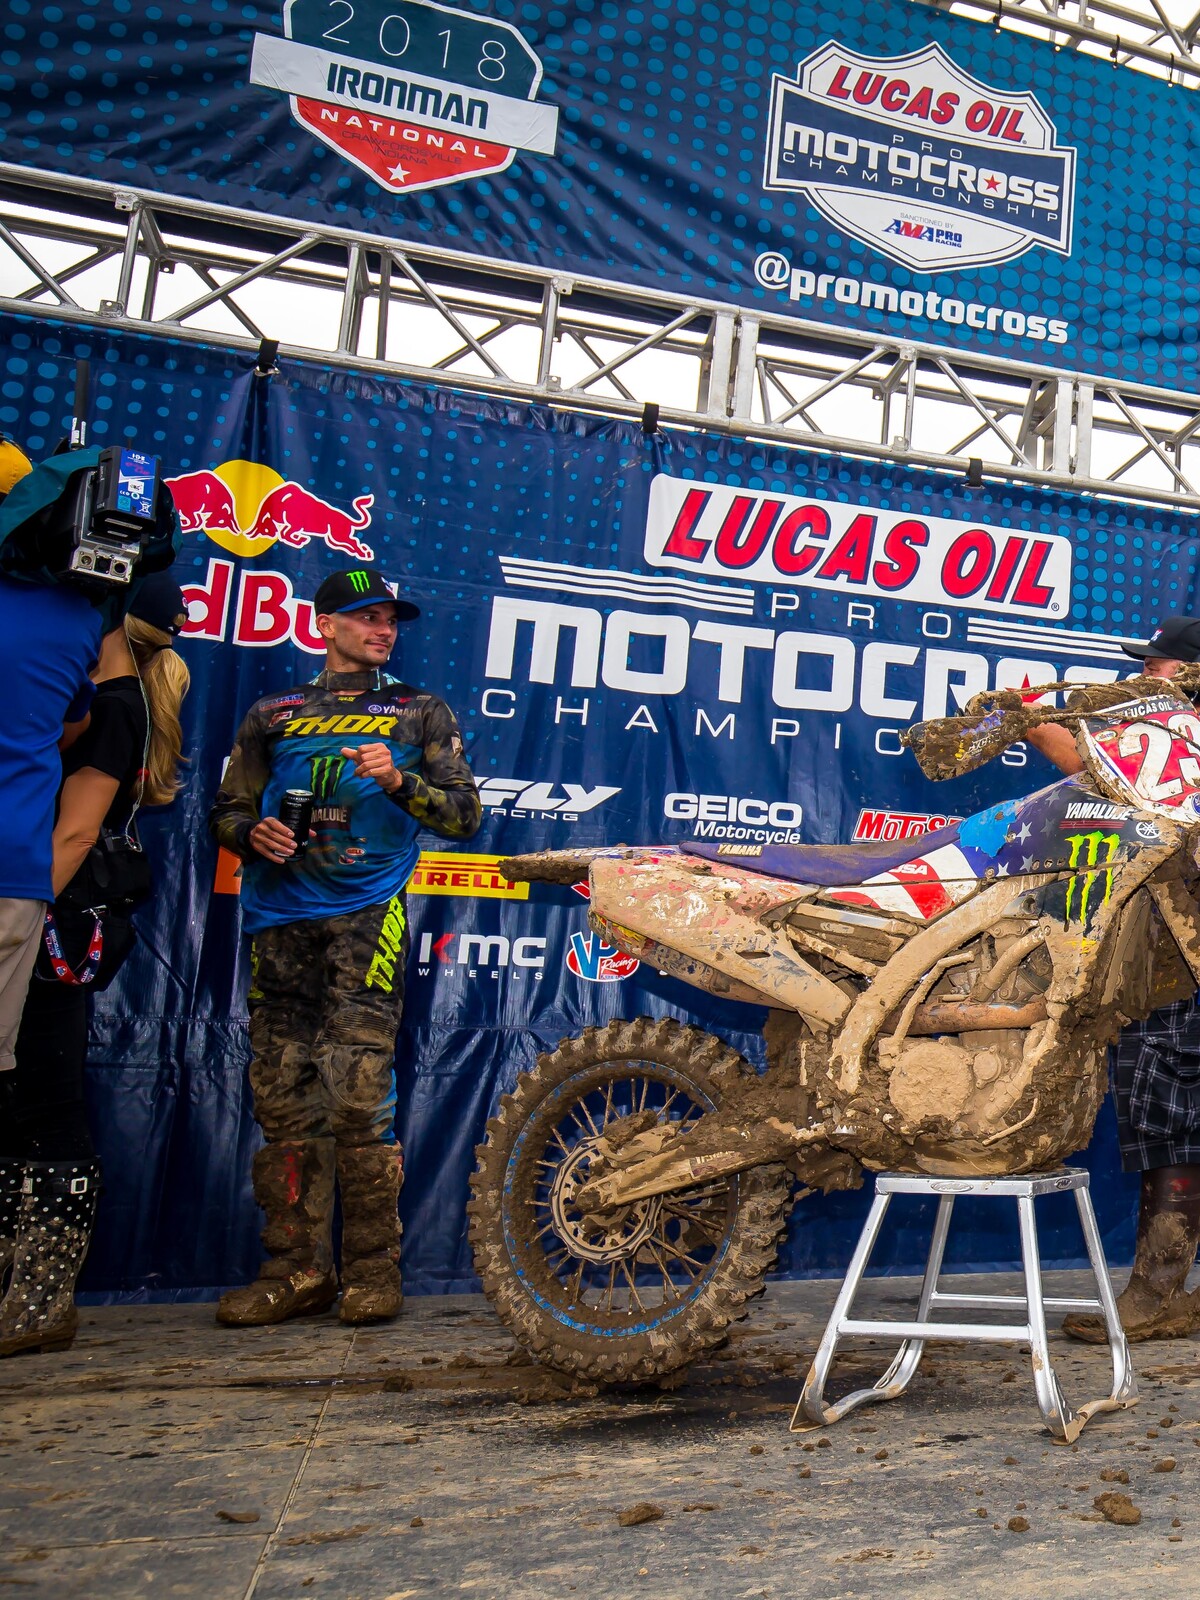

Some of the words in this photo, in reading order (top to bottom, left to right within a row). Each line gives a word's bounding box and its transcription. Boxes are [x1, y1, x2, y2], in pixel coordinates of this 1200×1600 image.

[322, 0, 506, 81] 2018
[327, 63, 489, 130] IRONMAN
[826, 65, 960, 125] LUCAS
[965, 100, 1025, 142] OIL
[321, 108, 487, 158] NATIONAL
[893, 134, 962, 160] PRO
[374, 147, 429, 166] INDIANA
[784, 122, 1060, 211] MOTOCROSS
[782, 152, 1058, 222] CHAMPIONSHIP
[882, 218, 934, 242] AMA
[935, 228, 962, 242] PRO
[900, 212, 943, 227] SANCTIONED
[945, 221, 954, 229] BY
[935, 238, 962, 248] RACING
[754, 251, 1069, 344] @promotocross
[661, 487, 931, 592] LUCAS
[941, 528, 1055, 609] OIL
[237, 573, 328, 652] Bu
[771, 590, 953, 639] PRO
[383, 705, 424, 719] YAMAHA
[1125, 701, 1158, 718] LUCAS
[1159, 701, 1173, 712] OIL
[283, 714, 399, 737] THOR
[475, 776, 622, 813] FLY
[482, 807, 579, 822] ACING
[663, 792, 803, 829] GEICO
[693, 820, 801, 846] Motorcycle
[717, 843, 763, 856] YAMAHA
[408, 862, 516, 890] IRELLI
[570, 930, 619, 981] VP
[601, 957, 637, 974] Racing
[418, 967, 543, 981] WHEELS
